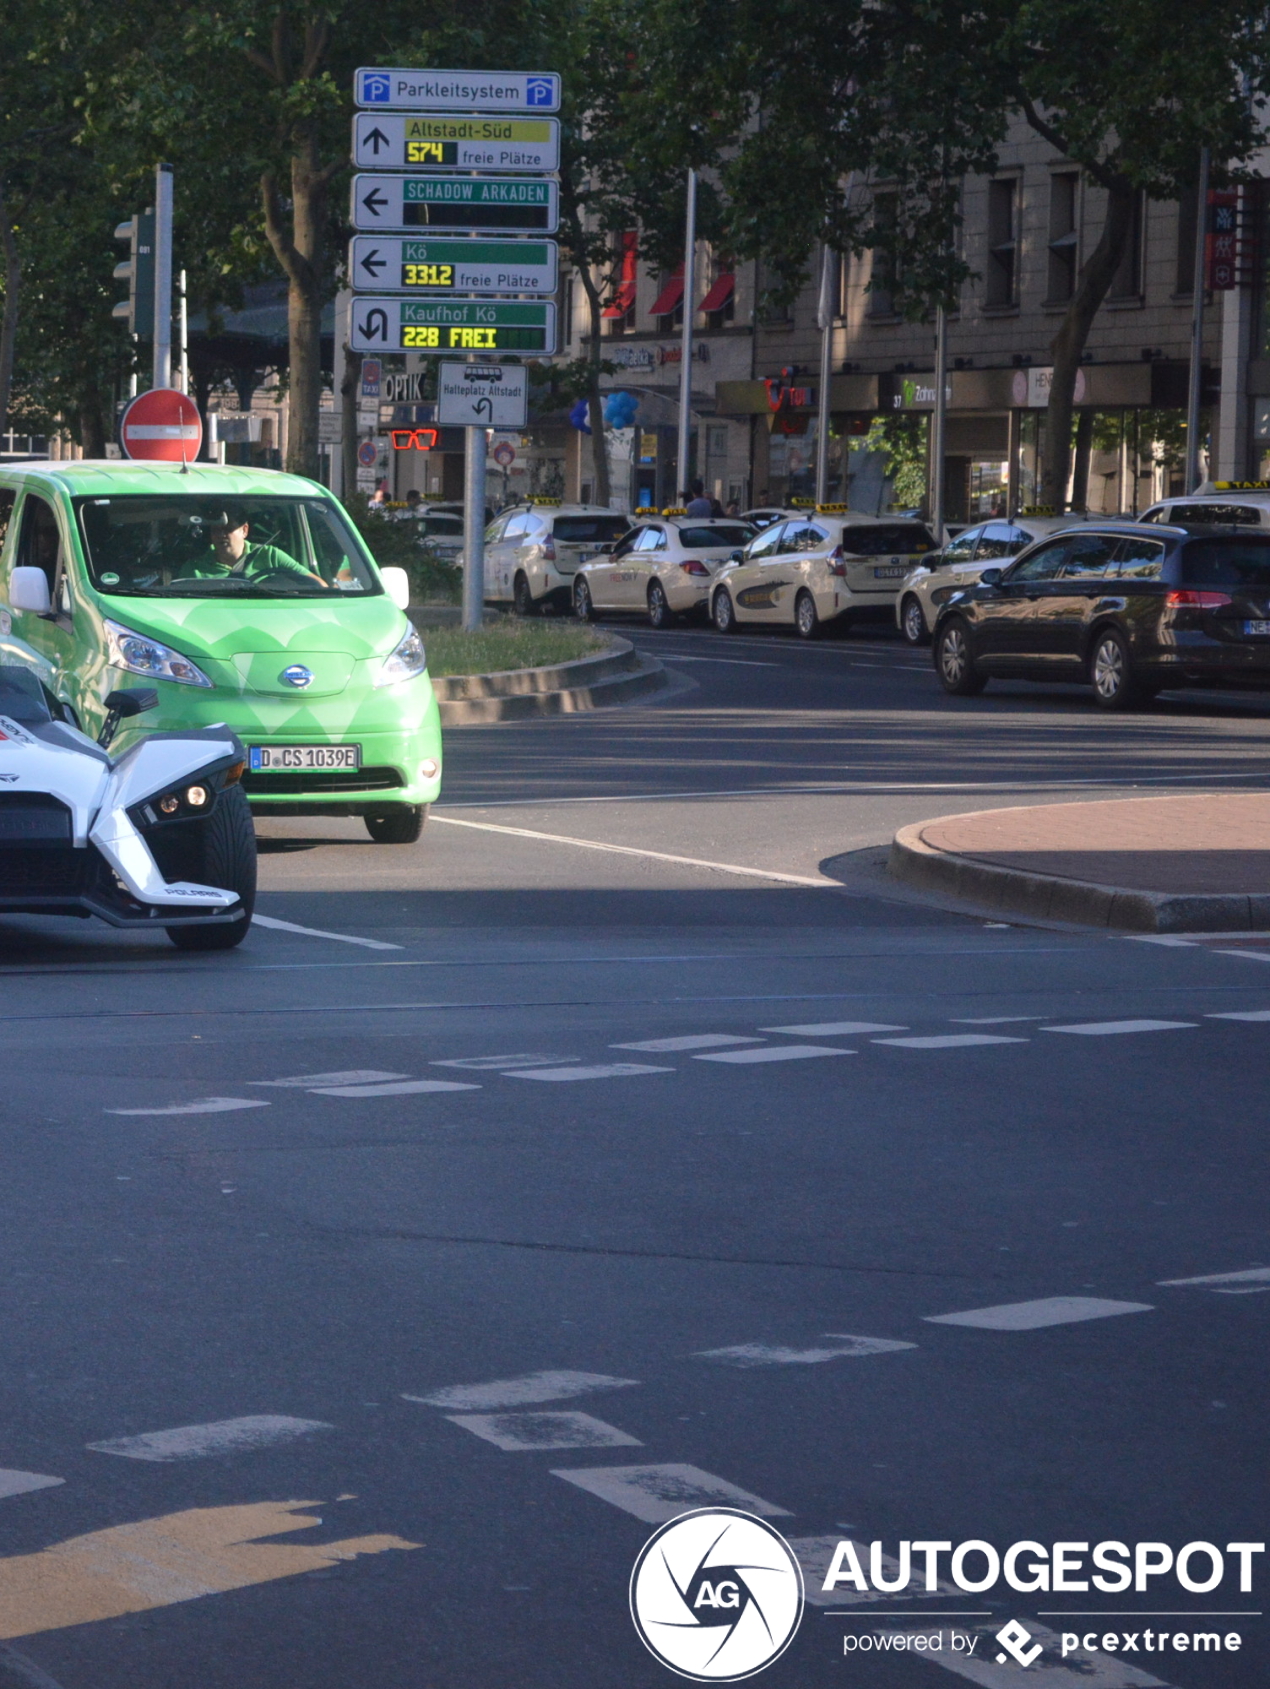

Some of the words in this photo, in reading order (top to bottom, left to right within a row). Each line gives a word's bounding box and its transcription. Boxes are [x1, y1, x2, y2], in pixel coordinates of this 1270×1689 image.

[397, 81, 520, 101] Parkleitsystem
[410, 122, 512, 139] Altstadt-Süd
[407, 142, 443, 162] 574
[463, 151, 494, 164] freie
[500, 151, 541, 165] Plätze
[408, 183, 473, 200] SCHADOW
[482, 185, 545, 201] ARKADEN
[406, 245, 427, 260] Kö
[404, 264, 452, 286] 3312
[460, 274, 492, 286] freie
[498, 274, 539, 287] Plätze
[405, 305, 469, 321] Kaufhof
[476, 307, 497, 322] Kö
[403, 326, 439, 347] 228
[449, 328, 497, 348] FREI
[363, 385, 379, 393] TAXI
[385, 372, 422, 402] OPTIK
[443, 384, 486, 397] Halteplatz
[489, 386, 522, 397] Altstadt
[1250, 622, 1265, 633] NE
[261, 749, 271, 767] D
[282, 749, 303, 767] CS
[306, 749, 355, 767] 1039E
[164, 888, 223, 898] POLARIS
